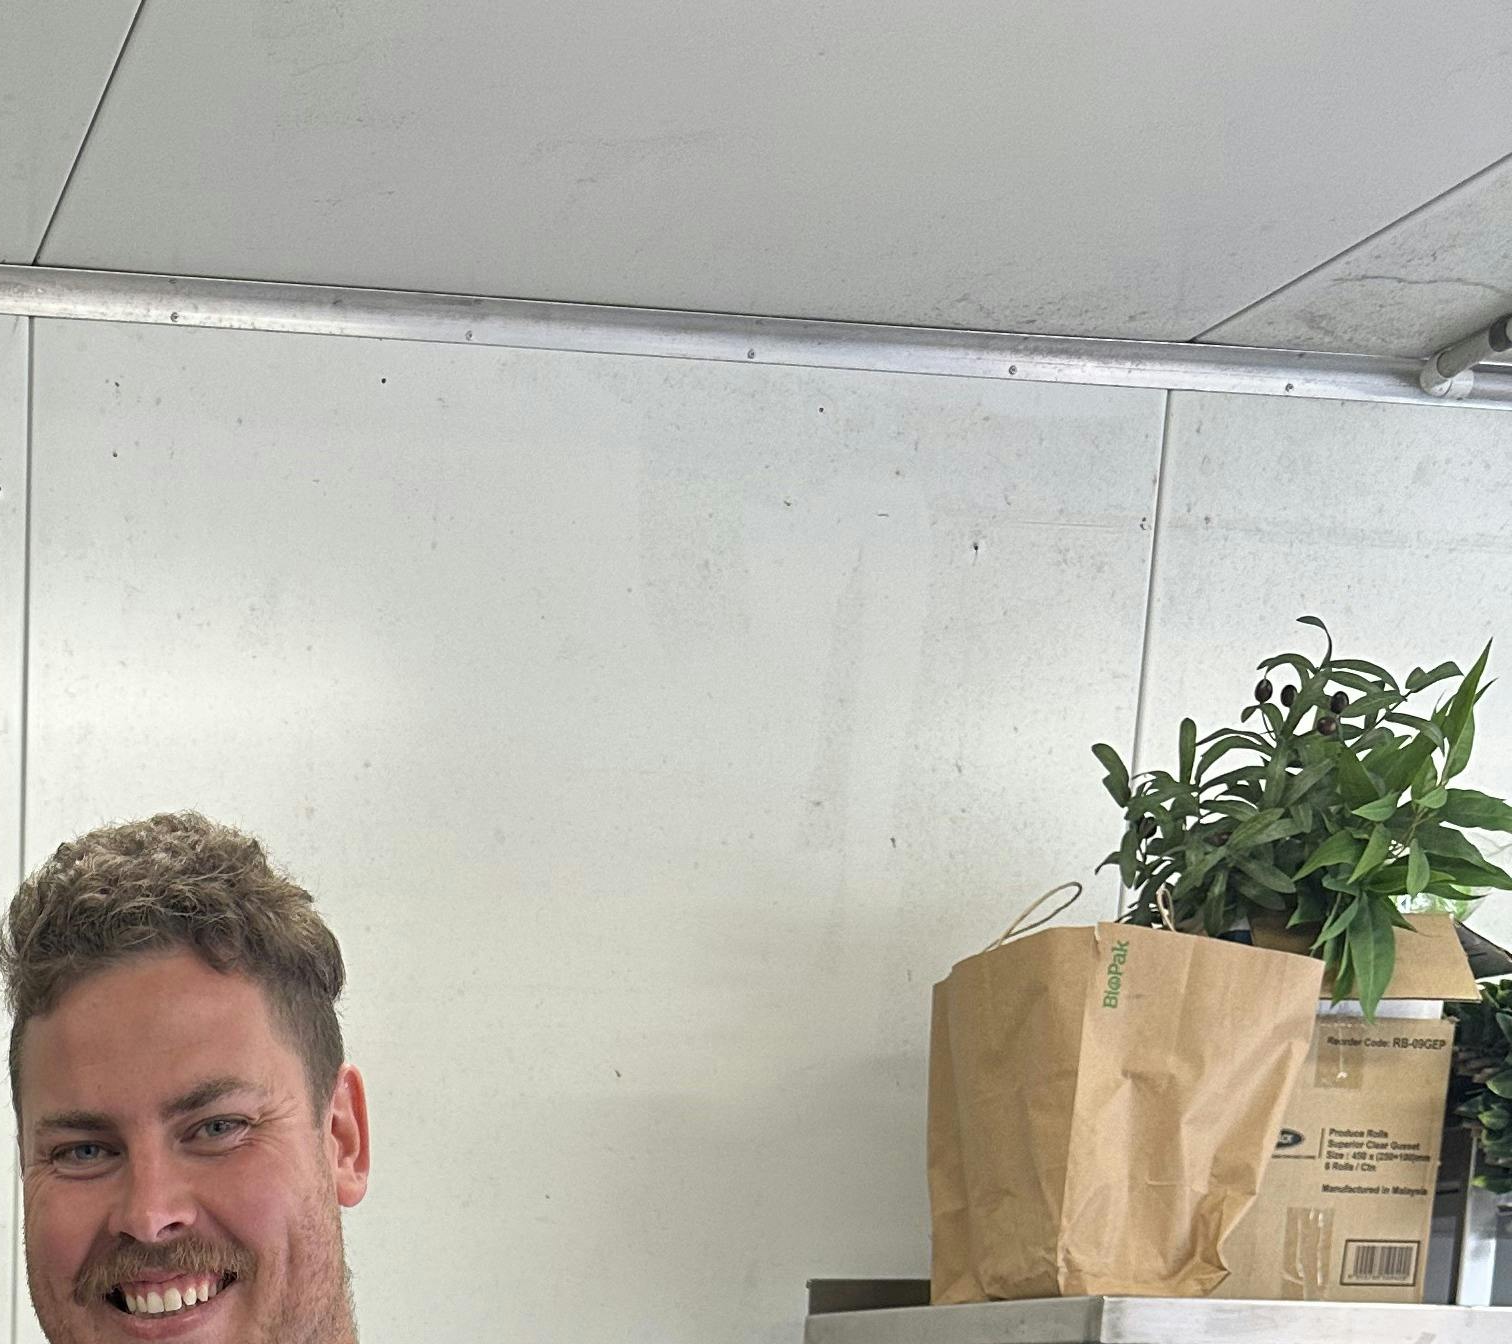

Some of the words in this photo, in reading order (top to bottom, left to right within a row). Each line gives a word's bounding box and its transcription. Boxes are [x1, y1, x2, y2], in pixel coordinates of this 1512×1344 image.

[1321, 1184, 1380, 1194] Manufactured
[1381, 1185, 1390, 1194] in
[1391, 1186, 1427, 1197] Malaysia
